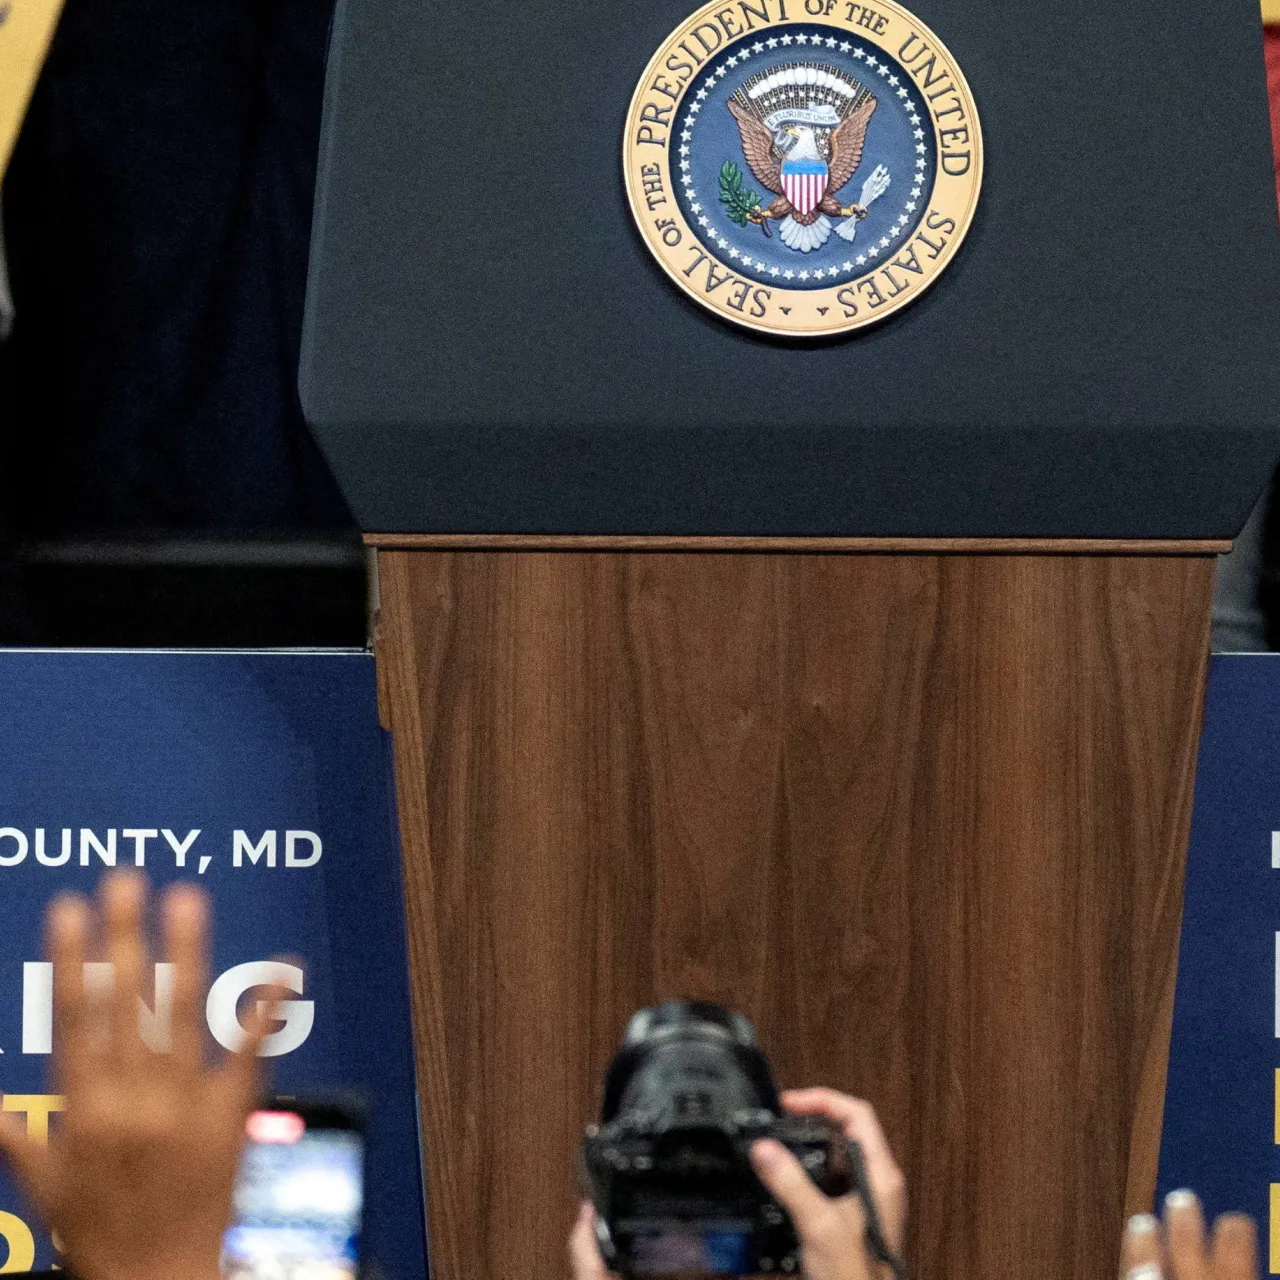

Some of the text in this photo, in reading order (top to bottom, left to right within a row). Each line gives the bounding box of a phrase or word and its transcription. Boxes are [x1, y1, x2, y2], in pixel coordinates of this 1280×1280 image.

[844, 0, 891, 37] THE
[897, 31, 972, 177] UNITED
[640, 160, 669, 211] THE
[654, 216, 683, 248] OF
[682, 245, 773, 318] SEAL
[836, 208, 956, 319] STATES
[231, 830, 324, 868] MD
